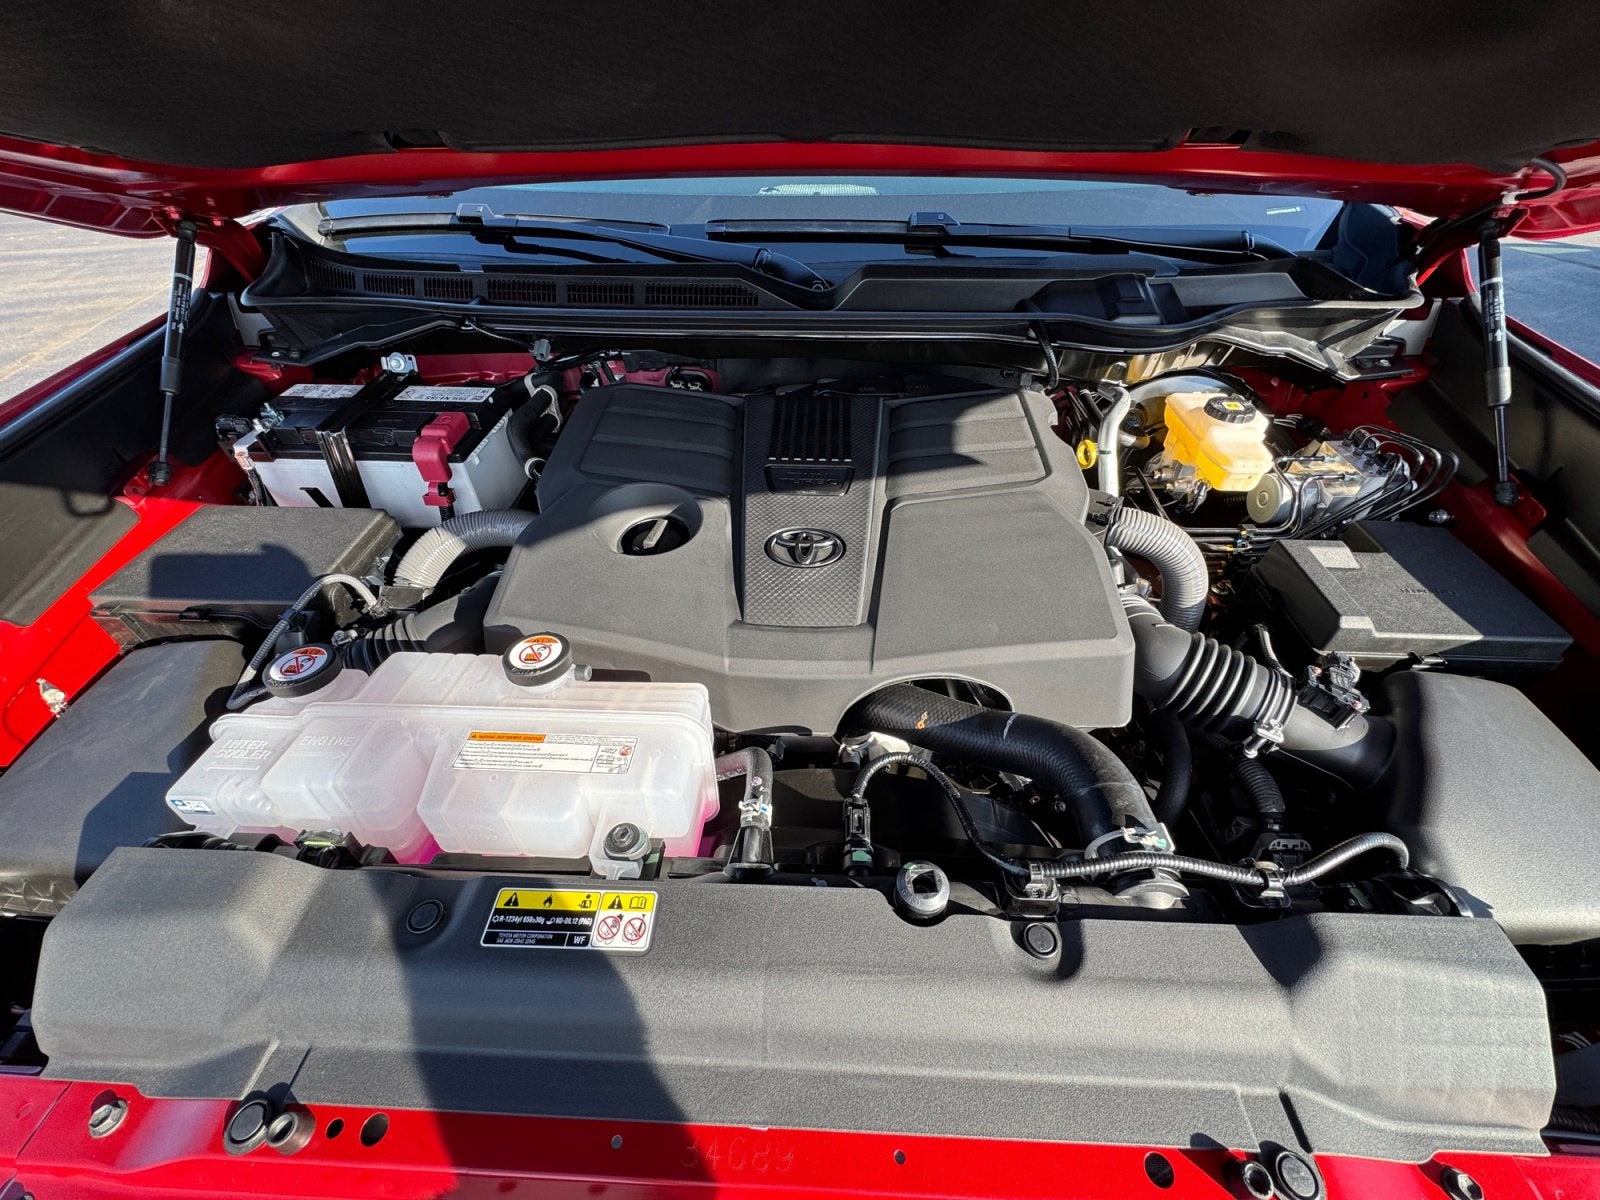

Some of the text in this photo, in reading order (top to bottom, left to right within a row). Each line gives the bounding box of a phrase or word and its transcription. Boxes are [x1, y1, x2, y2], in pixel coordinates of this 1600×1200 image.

[222, 739, 269, 749] INTER
[298, 735, 355, 746] ENGINE
[215, 749, 271, 760] COOLER
[573, 935, 587, 944] WF
